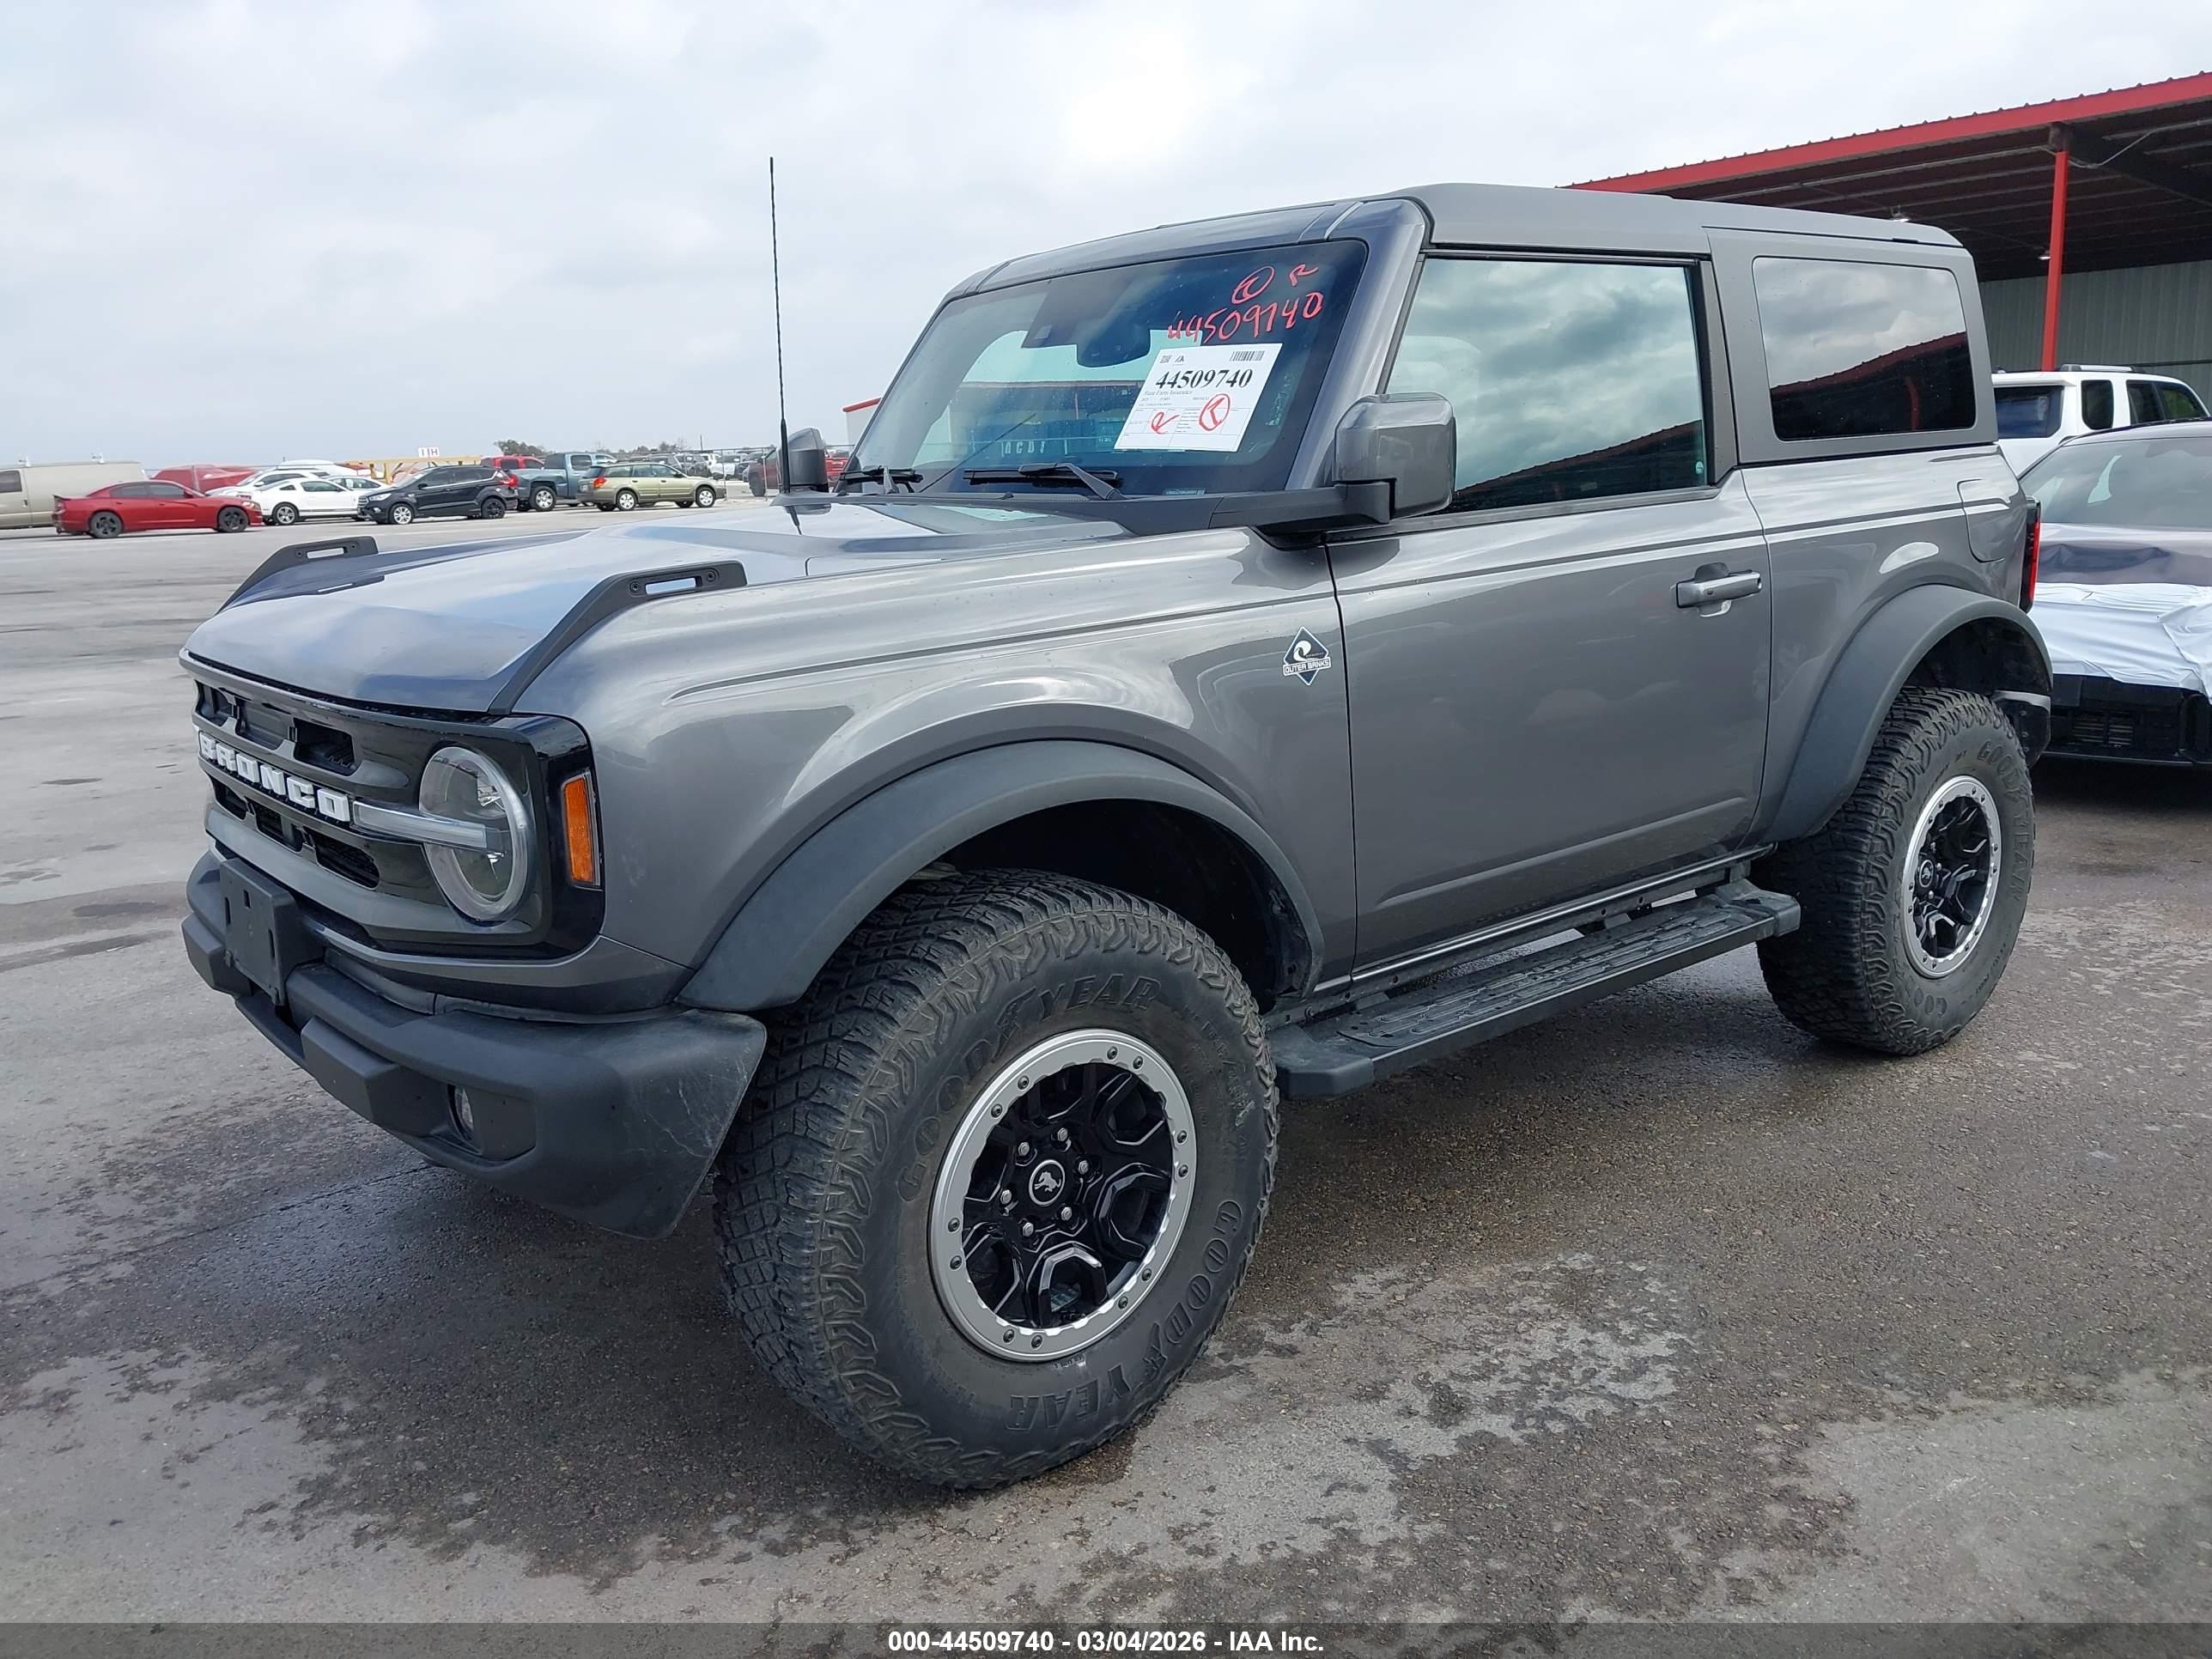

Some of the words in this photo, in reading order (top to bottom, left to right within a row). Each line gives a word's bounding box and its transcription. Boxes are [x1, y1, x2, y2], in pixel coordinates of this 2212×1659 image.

[1156, 368, 1254, 389] 44509740
[1285, 664, 1306, 673] OUTER
[1308, 659, 1328, 669] BANKS
[199, 732, 350, 823] BRONCO
